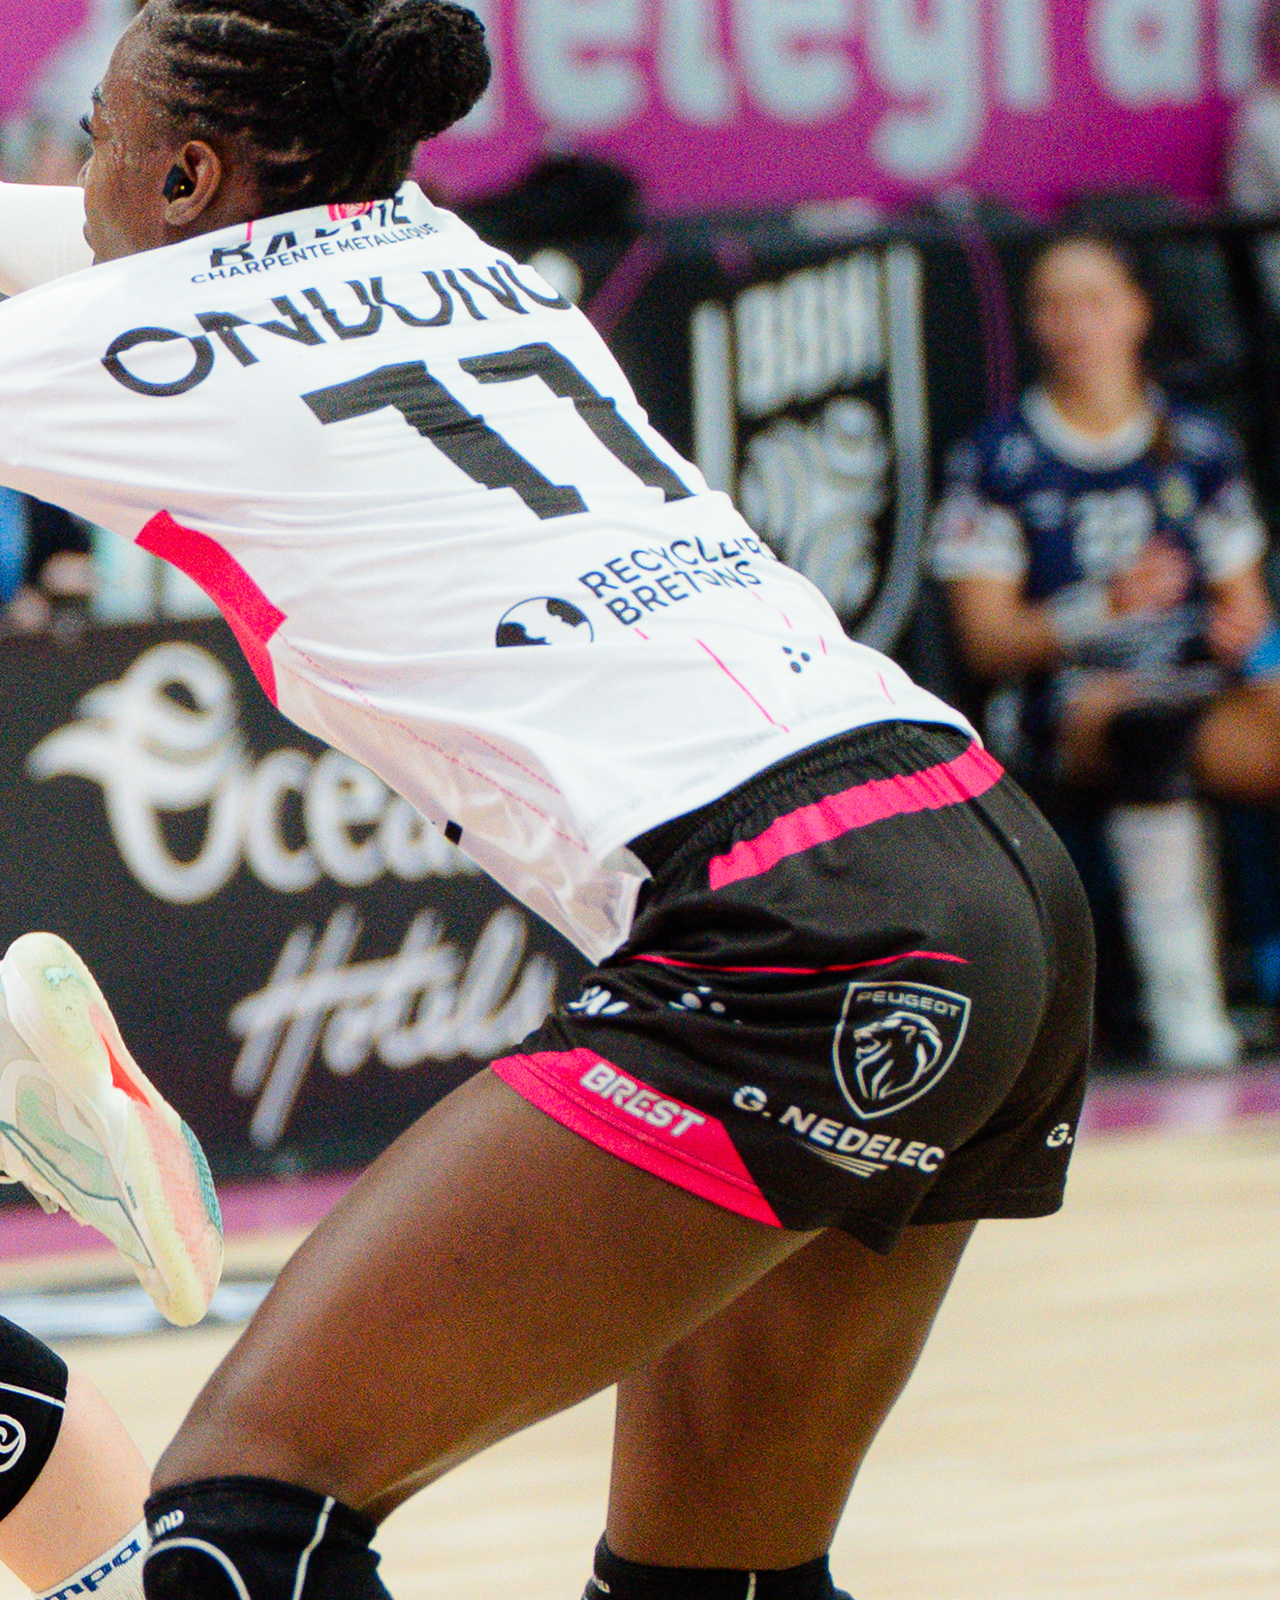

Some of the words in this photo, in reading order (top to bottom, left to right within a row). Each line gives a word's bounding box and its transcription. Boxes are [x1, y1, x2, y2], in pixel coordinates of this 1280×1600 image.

[191, 242, 334, 284] CHARPENTE
[300, 340, 700, 520] 77
[856, 990, 961, 1017] PEUGEOT
[578, 1062, 706, 1137] BREST
[779, 1104, 945, 1174] NEDELEC
